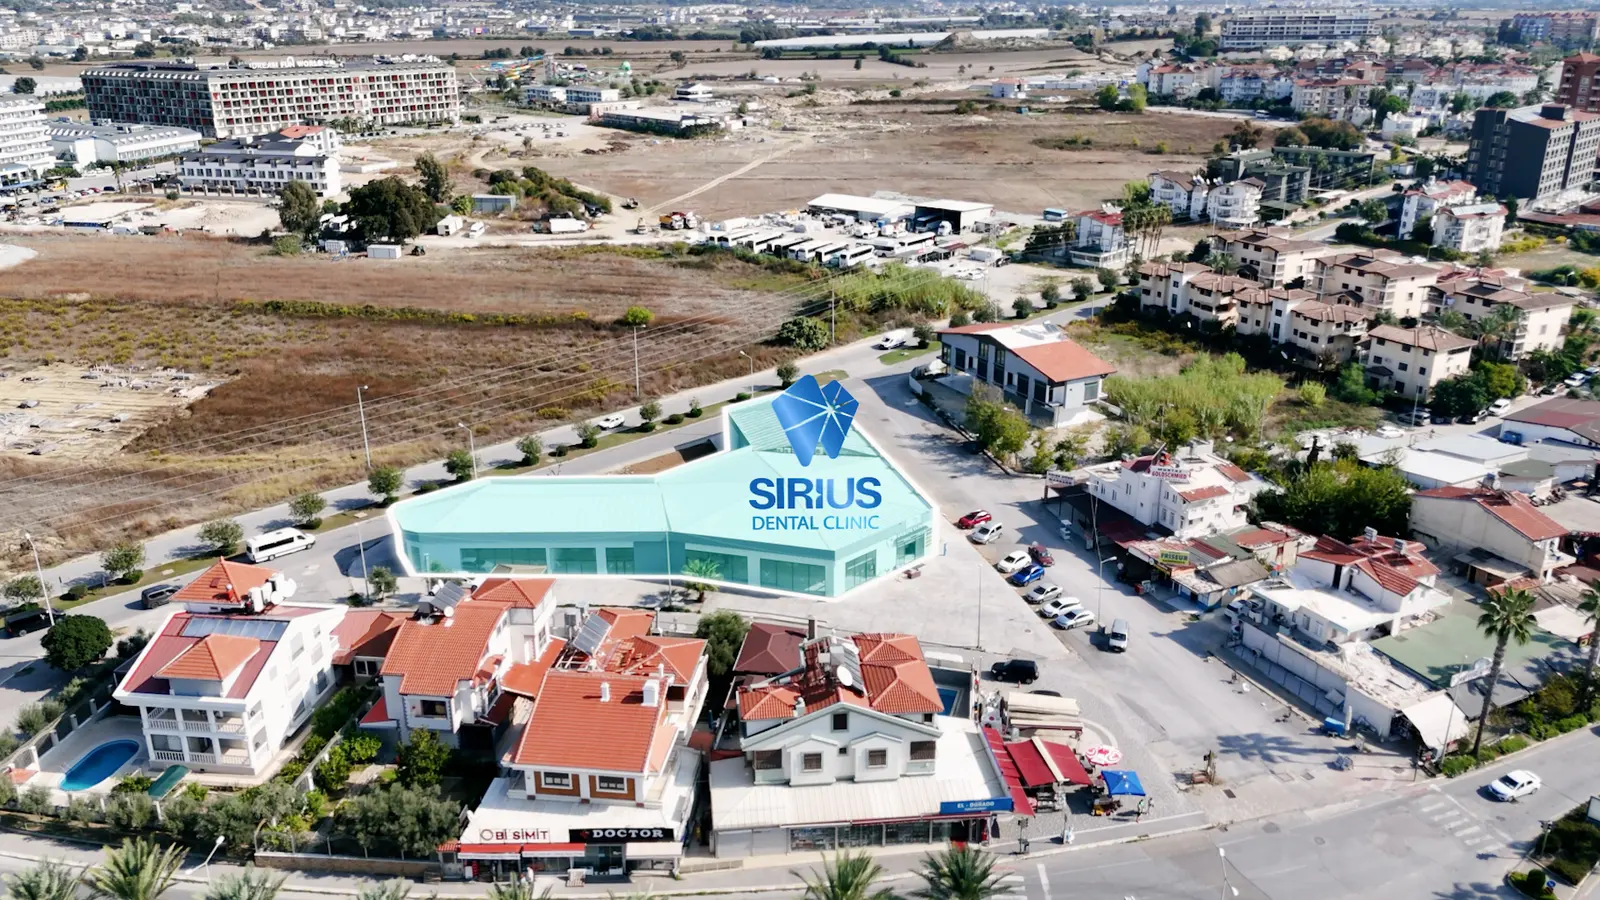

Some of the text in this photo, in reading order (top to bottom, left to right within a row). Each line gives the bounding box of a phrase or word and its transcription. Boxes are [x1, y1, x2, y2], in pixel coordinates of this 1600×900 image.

[1152, 471, 1187, 479] GOLDSCHMIED
[1160, 552, 1188, 561] FRISEUR
[593, 829, 664, 838] DOCTOR
